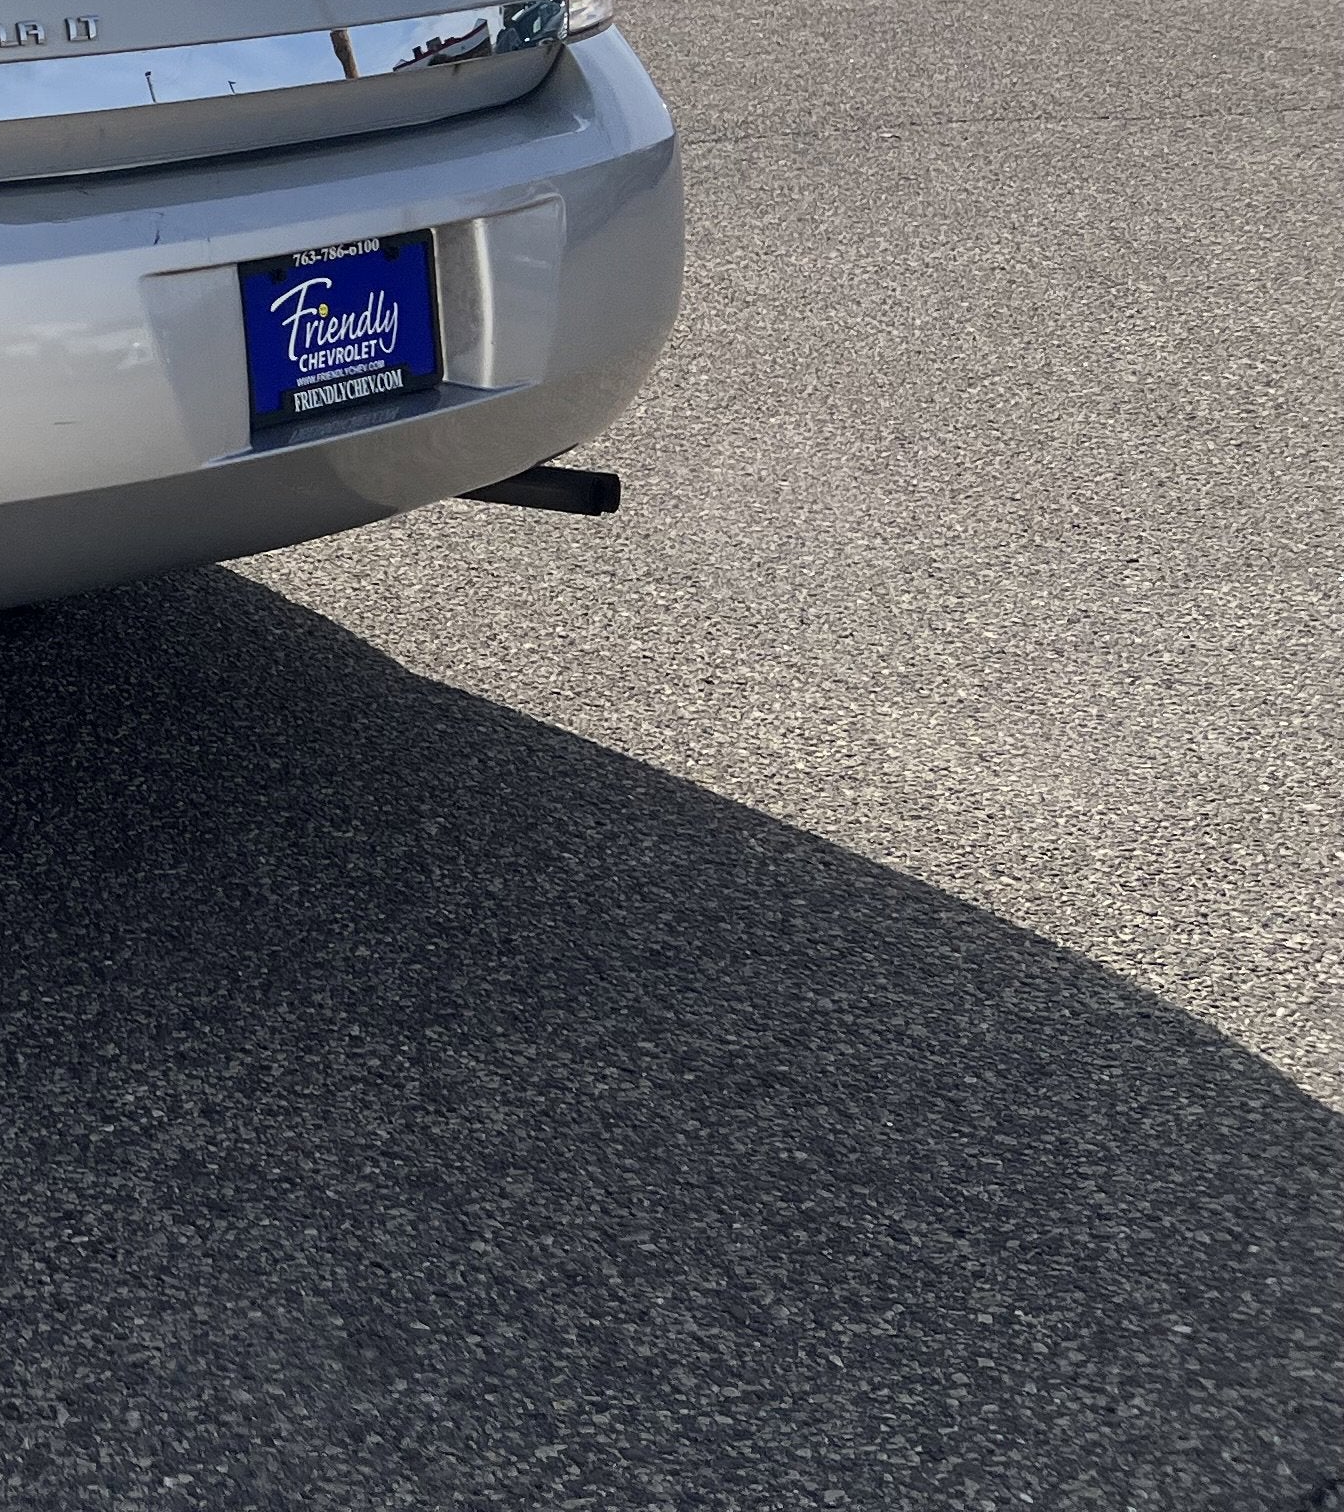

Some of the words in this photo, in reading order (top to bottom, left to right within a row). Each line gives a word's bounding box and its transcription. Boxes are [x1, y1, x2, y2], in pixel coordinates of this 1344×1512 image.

[64, 15, 100, 41] LT
[270, 277, 399, 361] Friendly
[299, 339, 378, 373] CHEVROLET
[293, 368, 404, 413] FRIENDLYCHEV.COM
